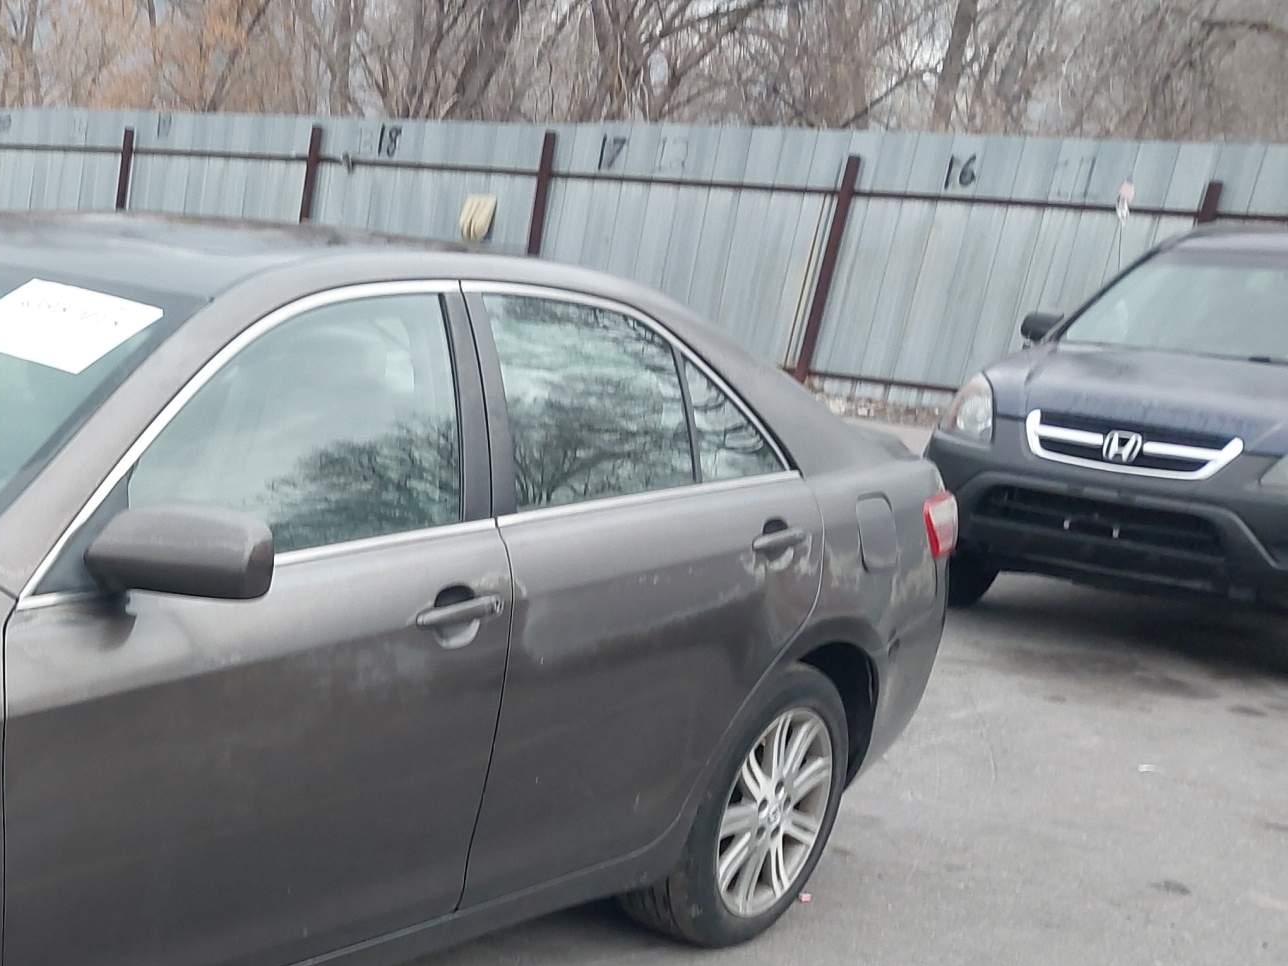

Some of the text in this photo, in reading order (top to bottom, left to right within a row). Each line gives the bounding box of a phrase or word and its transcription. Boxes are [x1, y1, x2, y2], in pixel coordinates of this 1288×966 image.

[377, 121, 403, 158] 18
[597, 133, 627, 170] 17
[943, 152, 977, 191] 16
